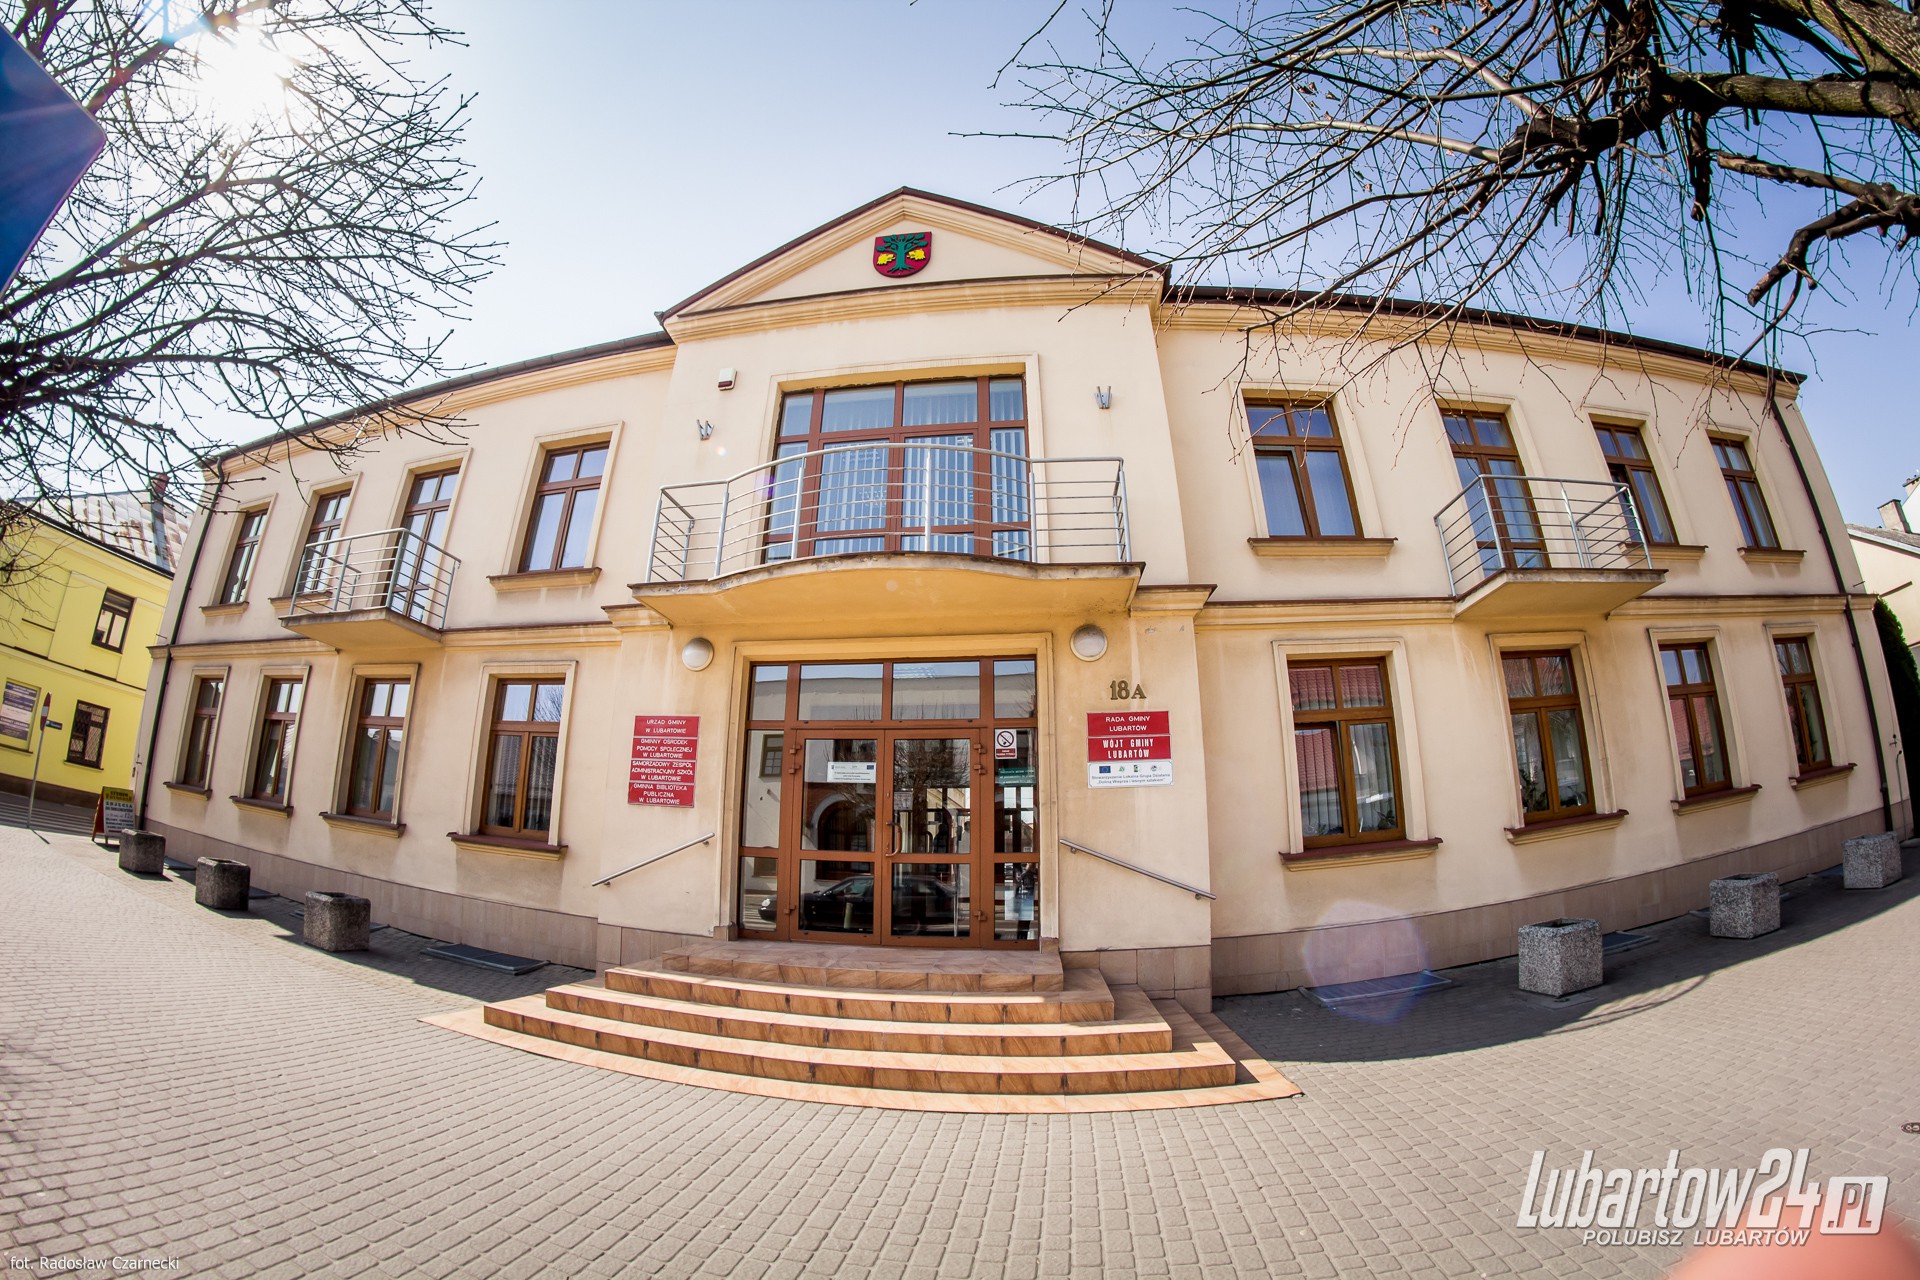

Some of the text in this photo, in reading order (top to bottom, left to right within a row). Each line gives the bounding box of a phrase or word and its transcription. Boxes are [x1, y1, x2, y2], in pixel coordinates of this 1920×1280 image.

[1109, 724, 1148, 732] LUBARTÓW
[1102, 738, 1154, 749] WÓJT GMINY
[1107, 748, 1150, 759] LUBARTÓW
[643, 790, 674, 798] PUBLICZNA
[646, 797, 680, 805] LUBARTOWIE
